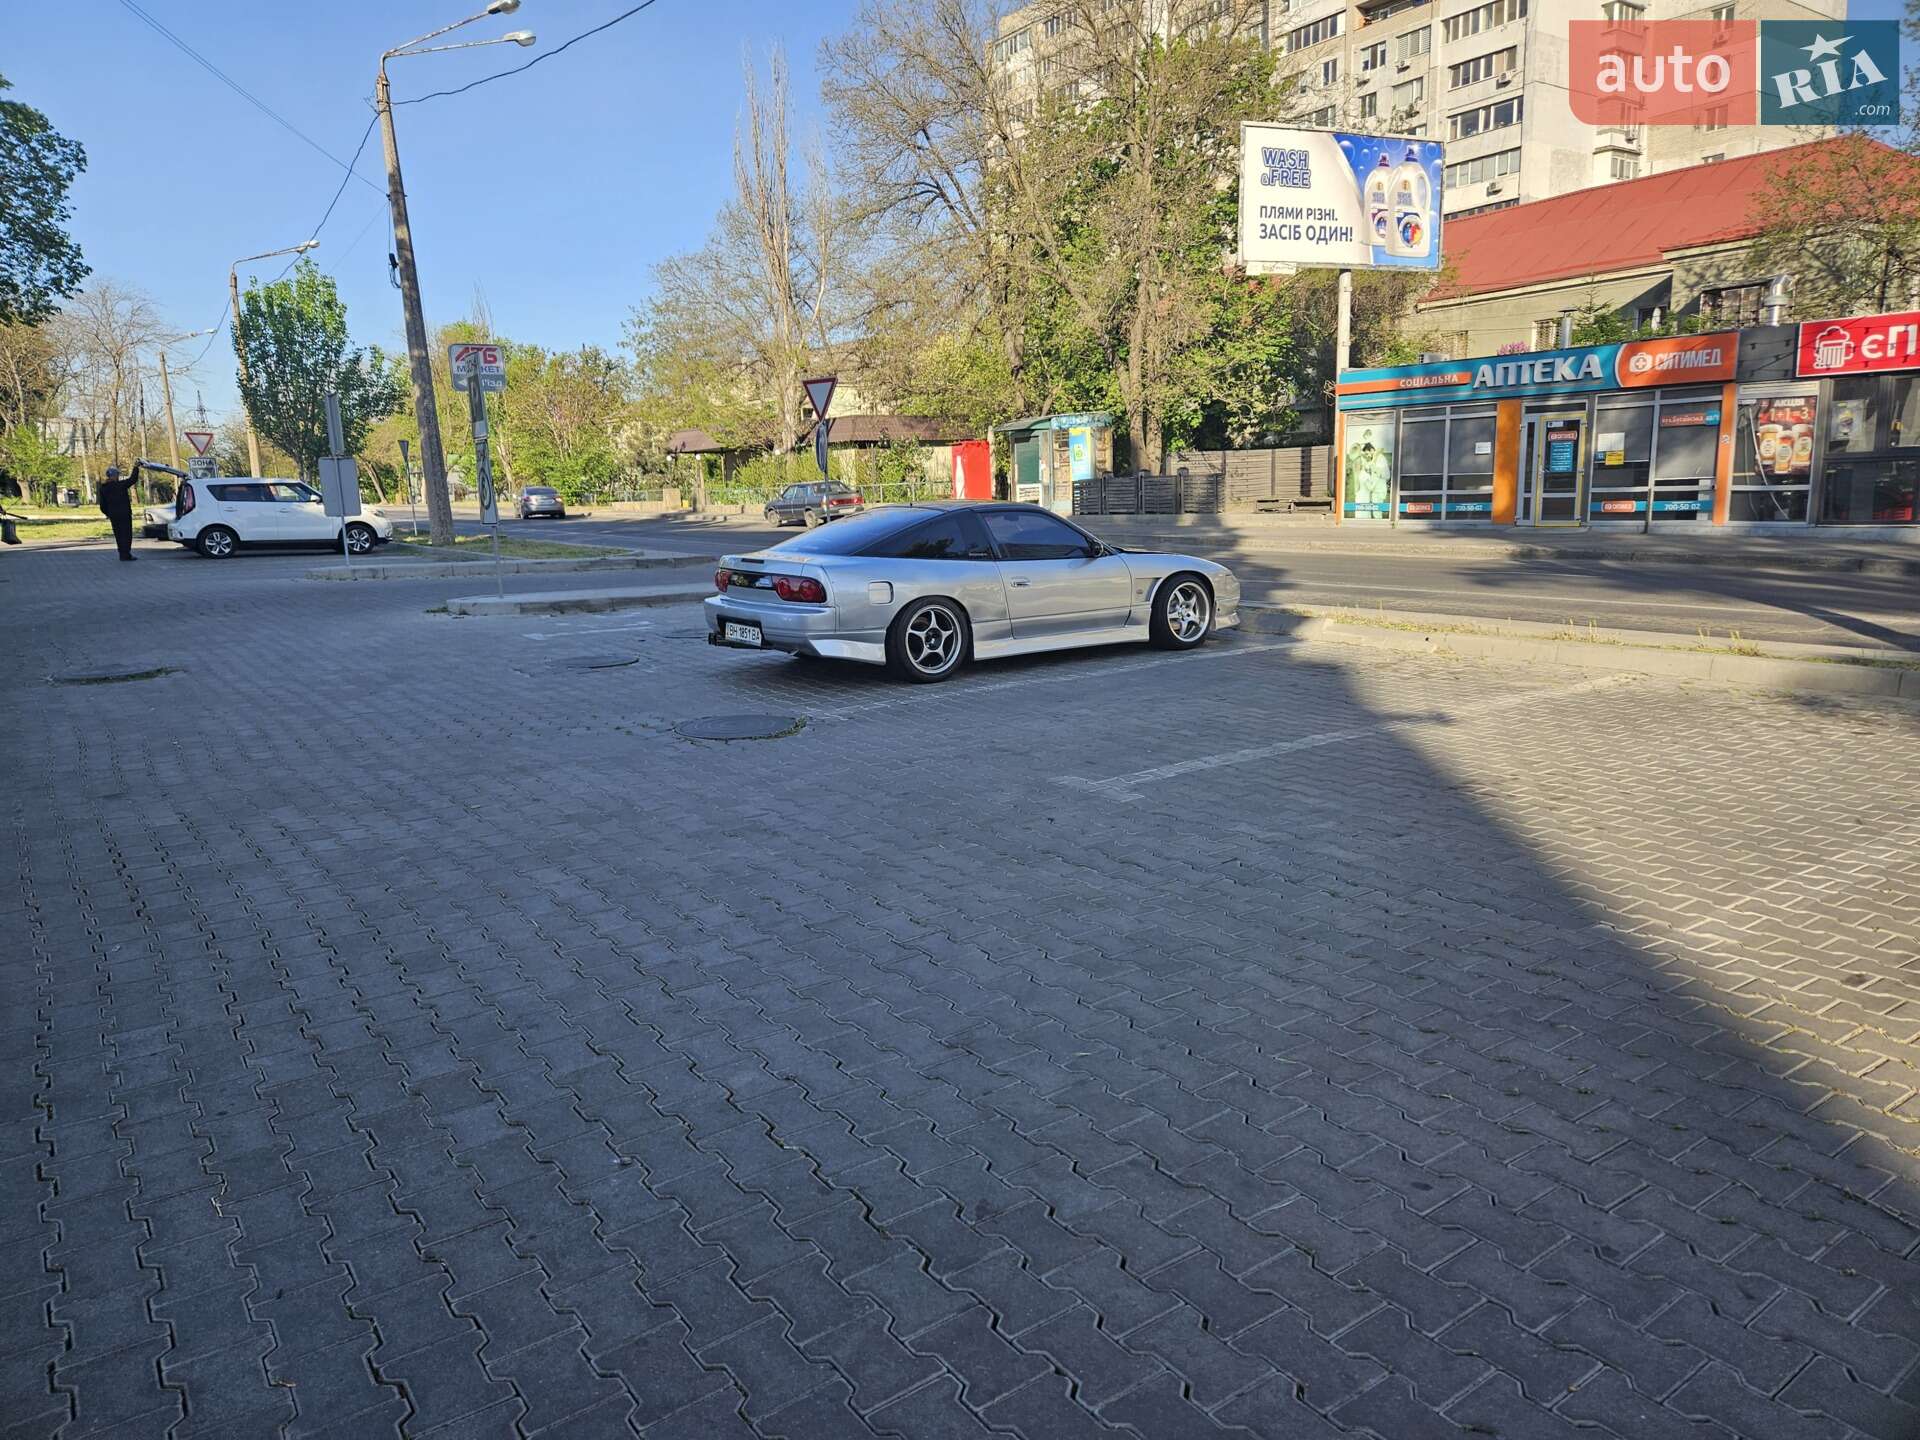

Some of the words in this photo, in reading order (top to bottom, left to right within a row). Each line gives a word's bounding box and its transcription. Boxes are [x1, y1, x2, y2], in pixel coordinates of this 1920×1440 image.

[1261, 147, 1309, 169] WASH
[1260, 205, 1303, 220] ПЛЯМИ
[1306, 207, 1338, 221] РІЗНІ.
[1259, 223, 1301, 241] ЗАСІБ
[1305, 225, 1353, 245] ОДИН!
[1655, 348, 1722, 371] СИТИМЕД
[1400, 374, 1459, 388] СОЦІАЛЬНА
[1473, 353, 1604, 390] АПТЕКА
